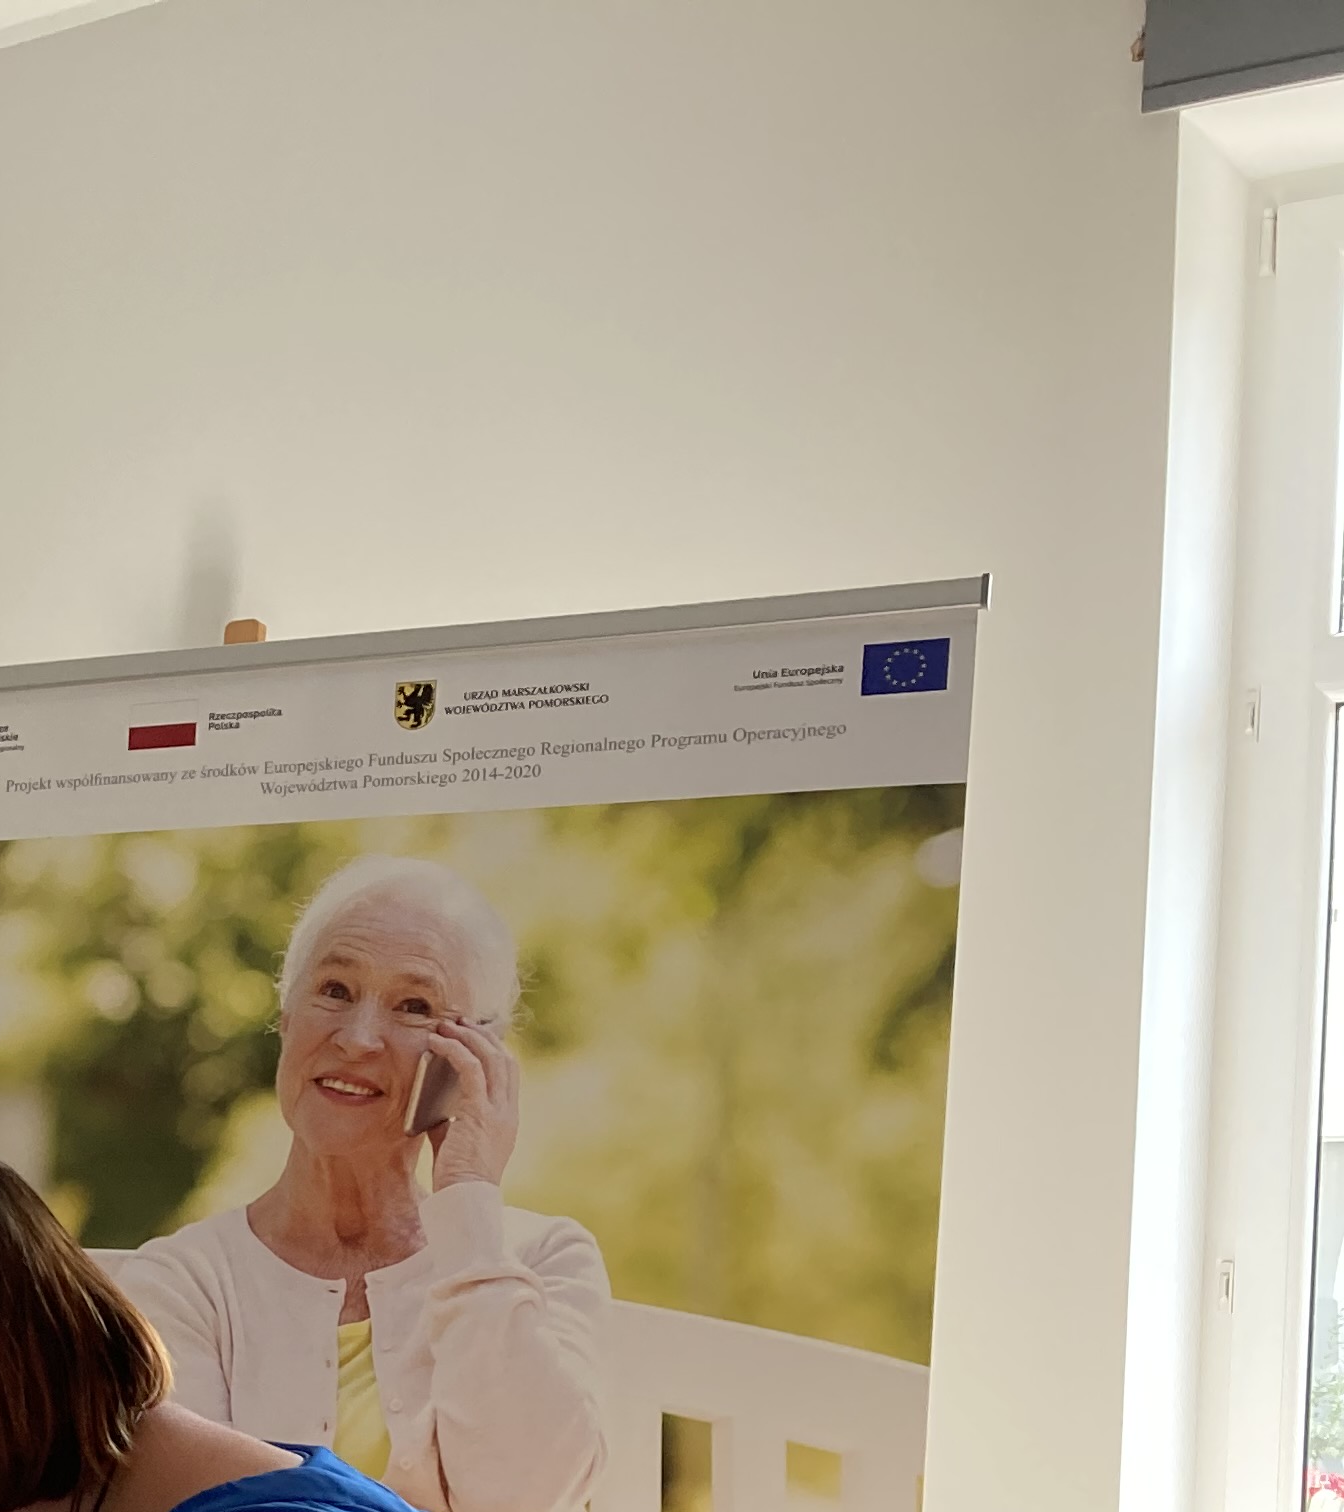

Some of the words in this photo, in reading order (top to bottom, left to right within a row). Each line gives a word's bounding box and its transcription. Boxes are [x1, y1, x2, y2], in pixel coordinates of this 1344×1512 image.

[753, 669, 778, 679] Unia
[781, 664, 844, 677] Europejska
[502, 682, 590, 698] MARSZAŁKOWSKI
[445, 700, 526, 715] WOJEWÓDZTWA
[529, 694, 609, 710] POMORSKIEGO
[208, 721, 240, 731] Polska
[6, 776, 52, 793] Projekt
[56, 770, 178, 791] współfinansowany
[181, 770, 196, 781] ze
[200, 762, 259, 780] środków
[264, 756, 364, 777] Europejskiego
[368, 750, 438, 768] Funduszu
[442, 744, 536, 765] Społecznego
[540, 737, 645, 757] Regionalnego
[650, 731, 728, 751] Programu
[733, 721, 847, 744] Operacyjnego
[260, 777, 358, 798] Województwa
[362, 769, 457, 791] Pomorskiego
[462, 763, 542, 783] 2014-2020
